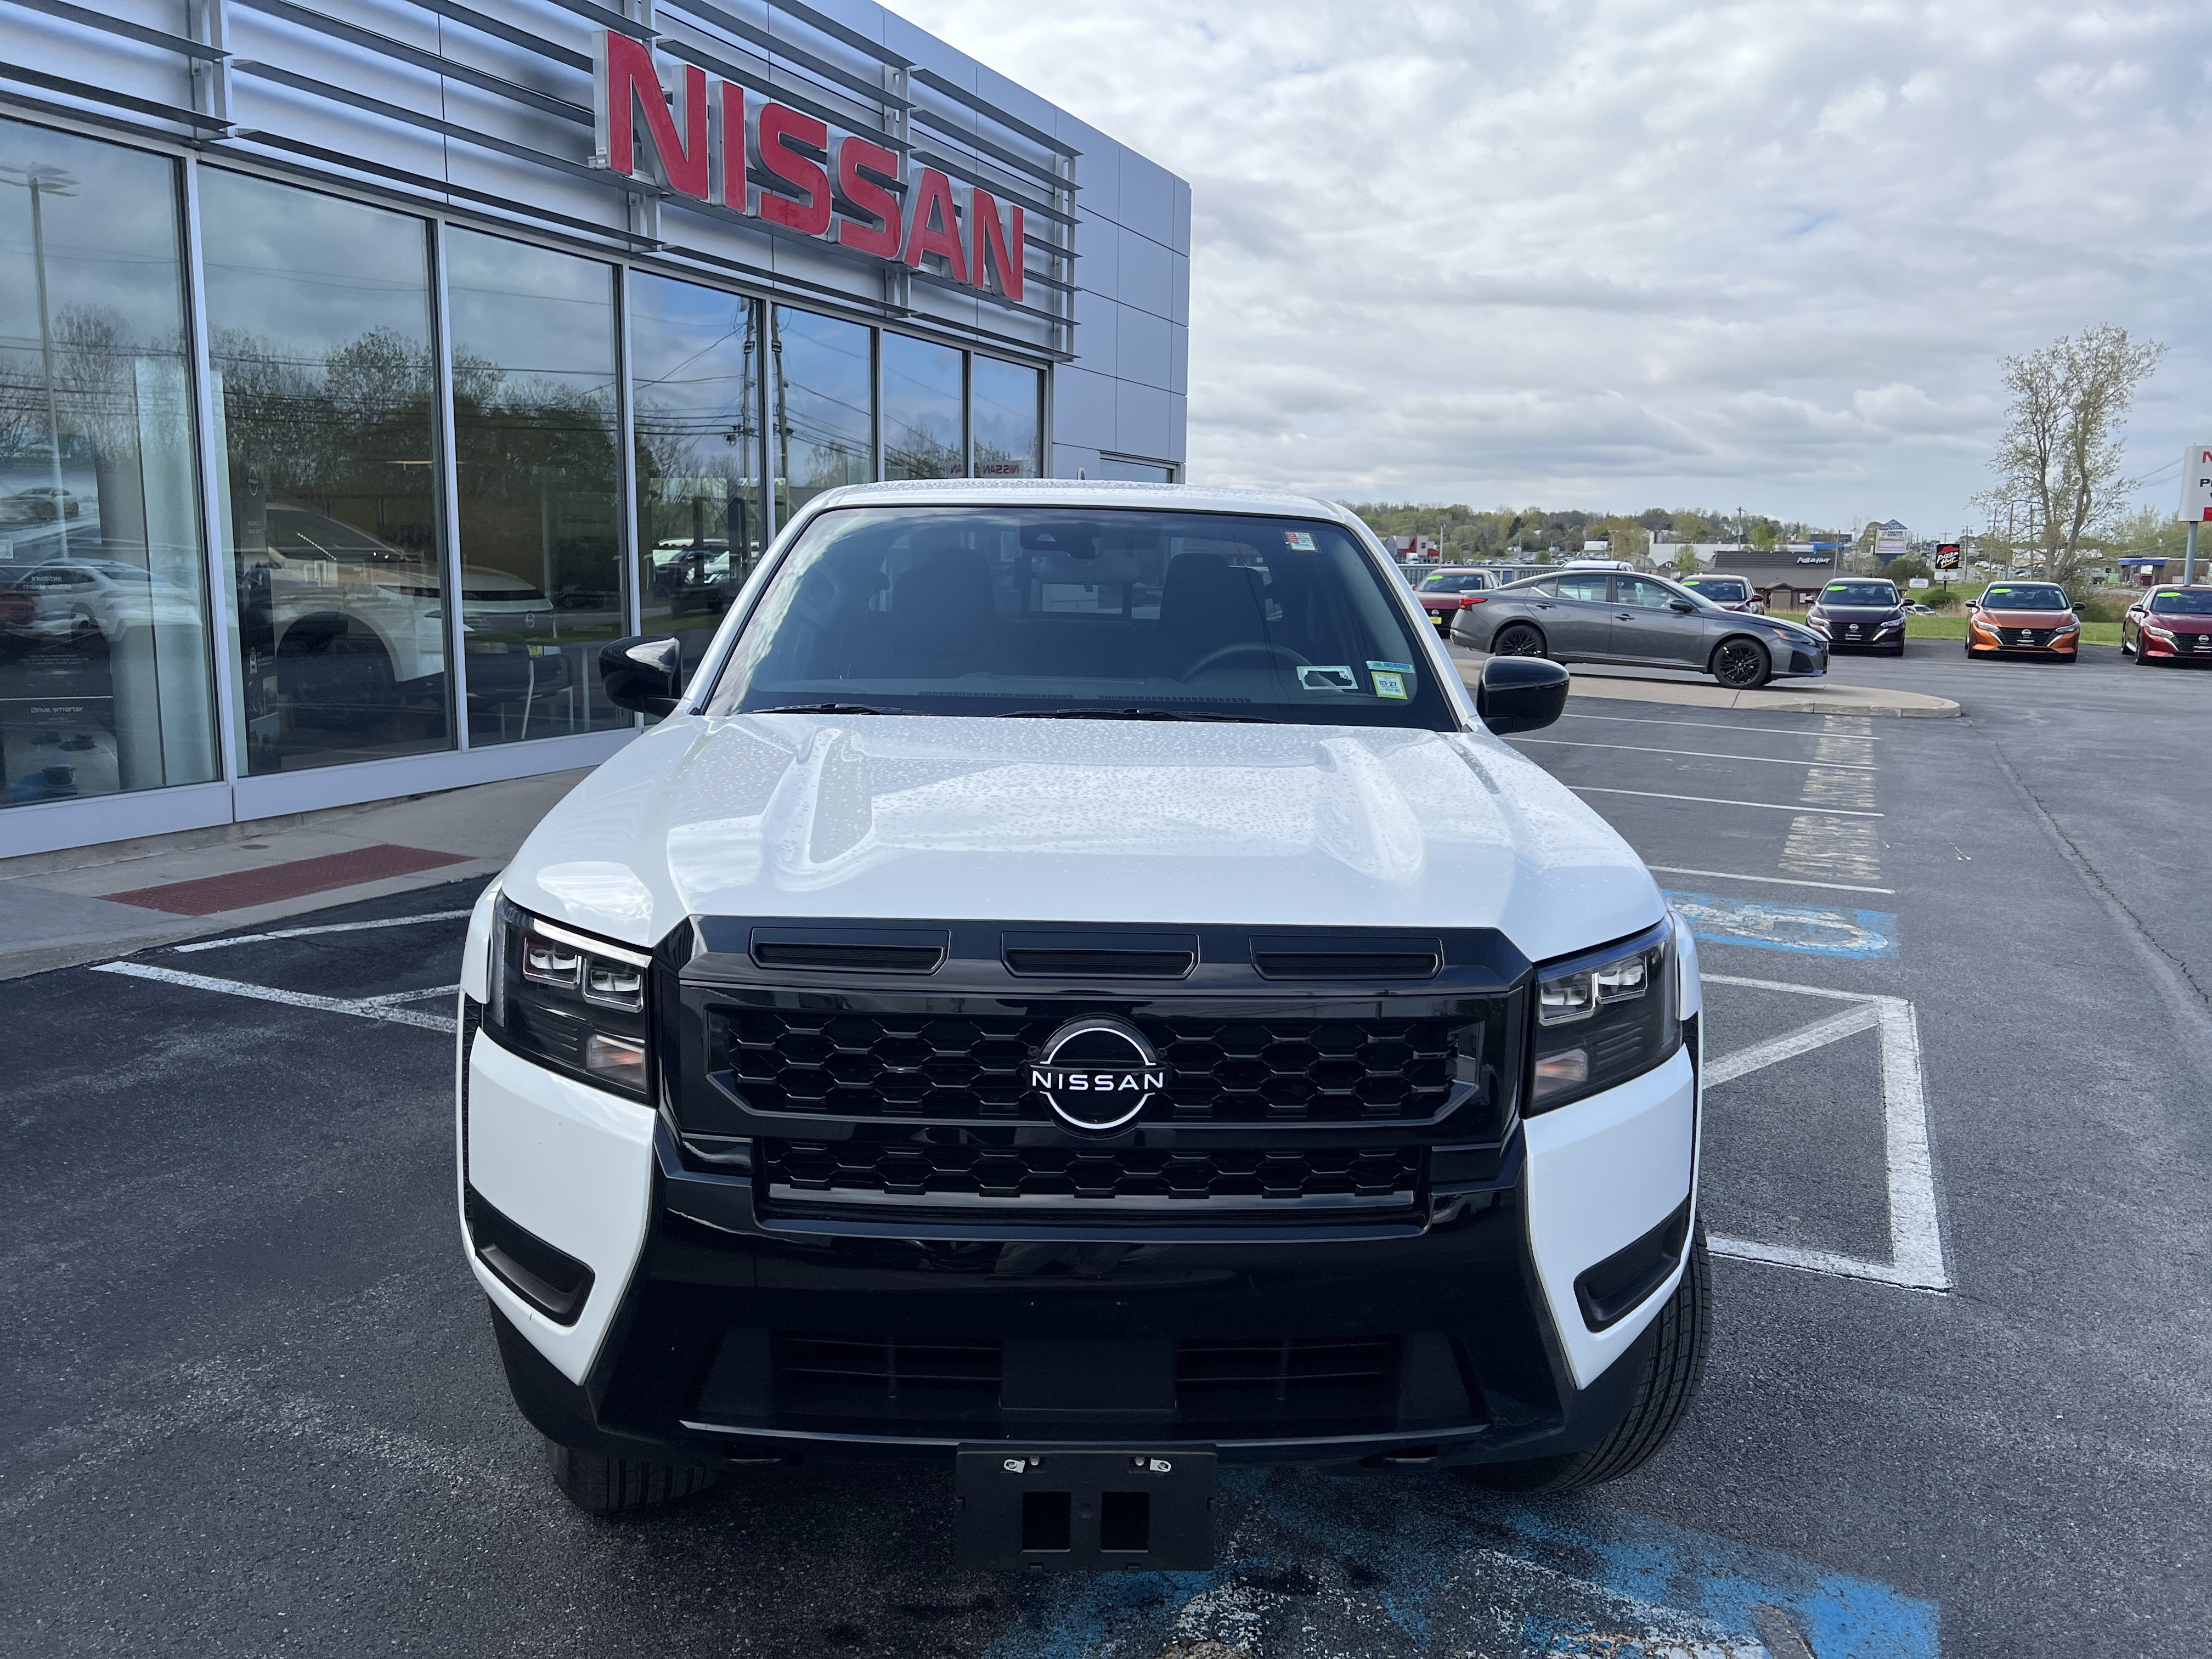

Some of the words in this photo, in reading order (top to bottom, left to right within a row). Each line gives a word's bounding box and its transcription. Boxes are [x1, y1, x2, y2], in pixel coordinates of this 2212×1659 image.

[594, 30, 1024, 302] NISSAN
[1937, 551, 1959, 565] Pizza
[1940, 556, 1956, 566] Hut
[1032, 1070, 1163, 1091] NISSAN
